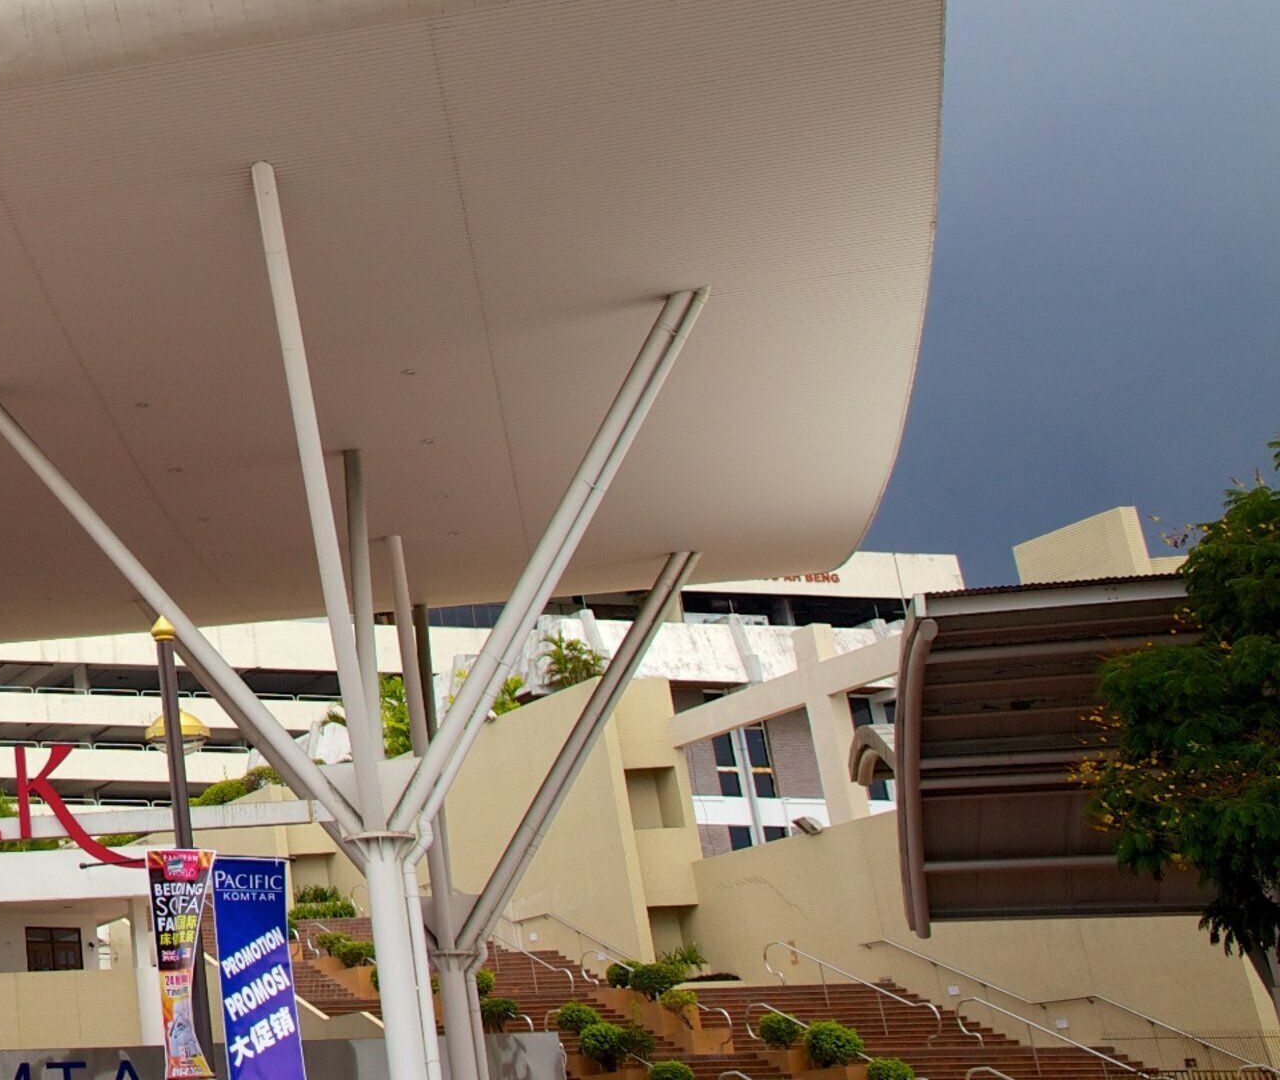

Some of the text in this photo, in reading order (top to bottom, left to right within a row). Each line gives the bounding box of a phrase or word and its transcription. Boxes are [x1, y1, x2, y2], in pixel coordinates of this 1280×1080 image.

[805, 571, 840, 583] BENG
[214, 870, 283, 890] PACIFIC
[156, 896, 199, 916] SOFA
[223, 891, 276, 901] KOMTAR
[221, 926, 285, 979] PROMOTION
[224, 964, 291, 1021] PROMOSI
[229, 1006, 295, 1067] 大促销
